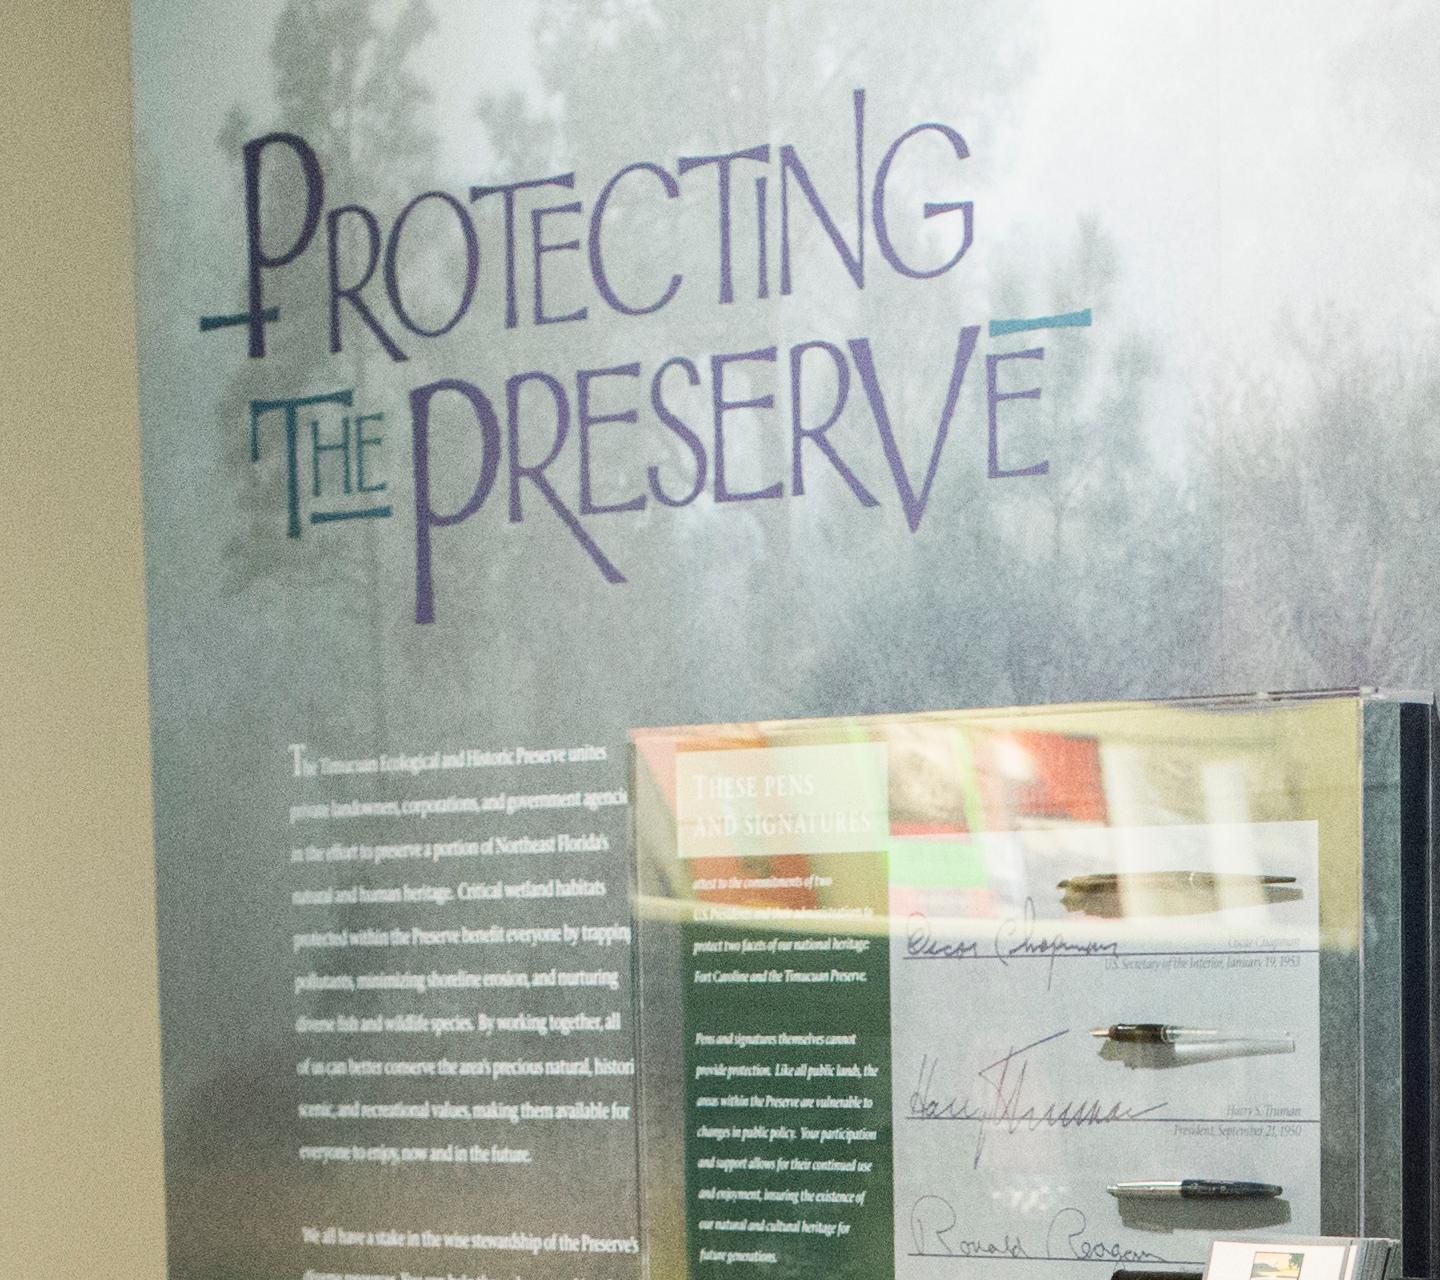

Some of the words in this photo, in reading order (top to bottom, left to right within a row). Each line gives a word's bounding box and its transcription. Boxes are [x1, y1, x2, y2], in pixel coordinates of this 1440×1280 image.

[251, 391, 392, 541] THE
[411, 325, 1050, 624] PRESERVE
[764, 774, 816, 797] PENS
[694, 814, 737, 837] AND
[743, 810, 872, 836] SIGNATURES
[556, 878, 607, 897] habitats
[1174, 957, 1188, 968] the
[1226, 956, 1263, 971] January
[716, 1032, 734, 1045] and
[863, 1064, 879, 1077] the
